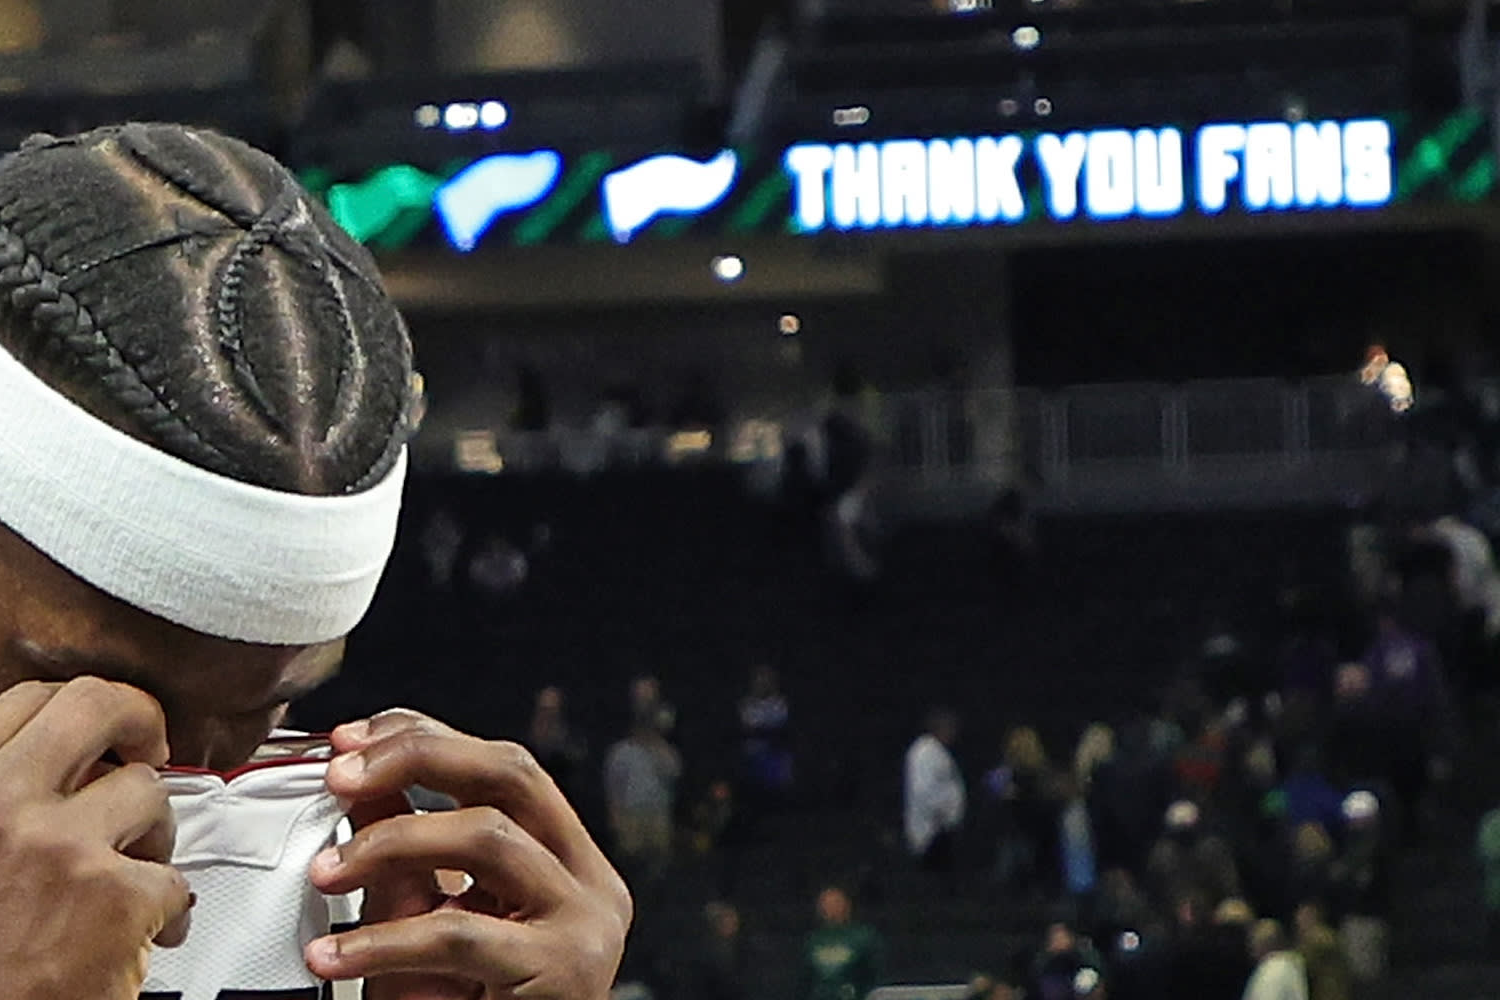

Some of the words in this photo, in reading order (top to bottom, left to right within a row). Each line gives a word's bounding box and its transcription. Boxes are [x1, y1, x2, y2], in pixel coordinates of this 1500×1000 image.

[787, 135, 1025, 228] THANK
[1037, 127, 1184, 217] YOU
[1198, 119, 1392, 210] FANS
